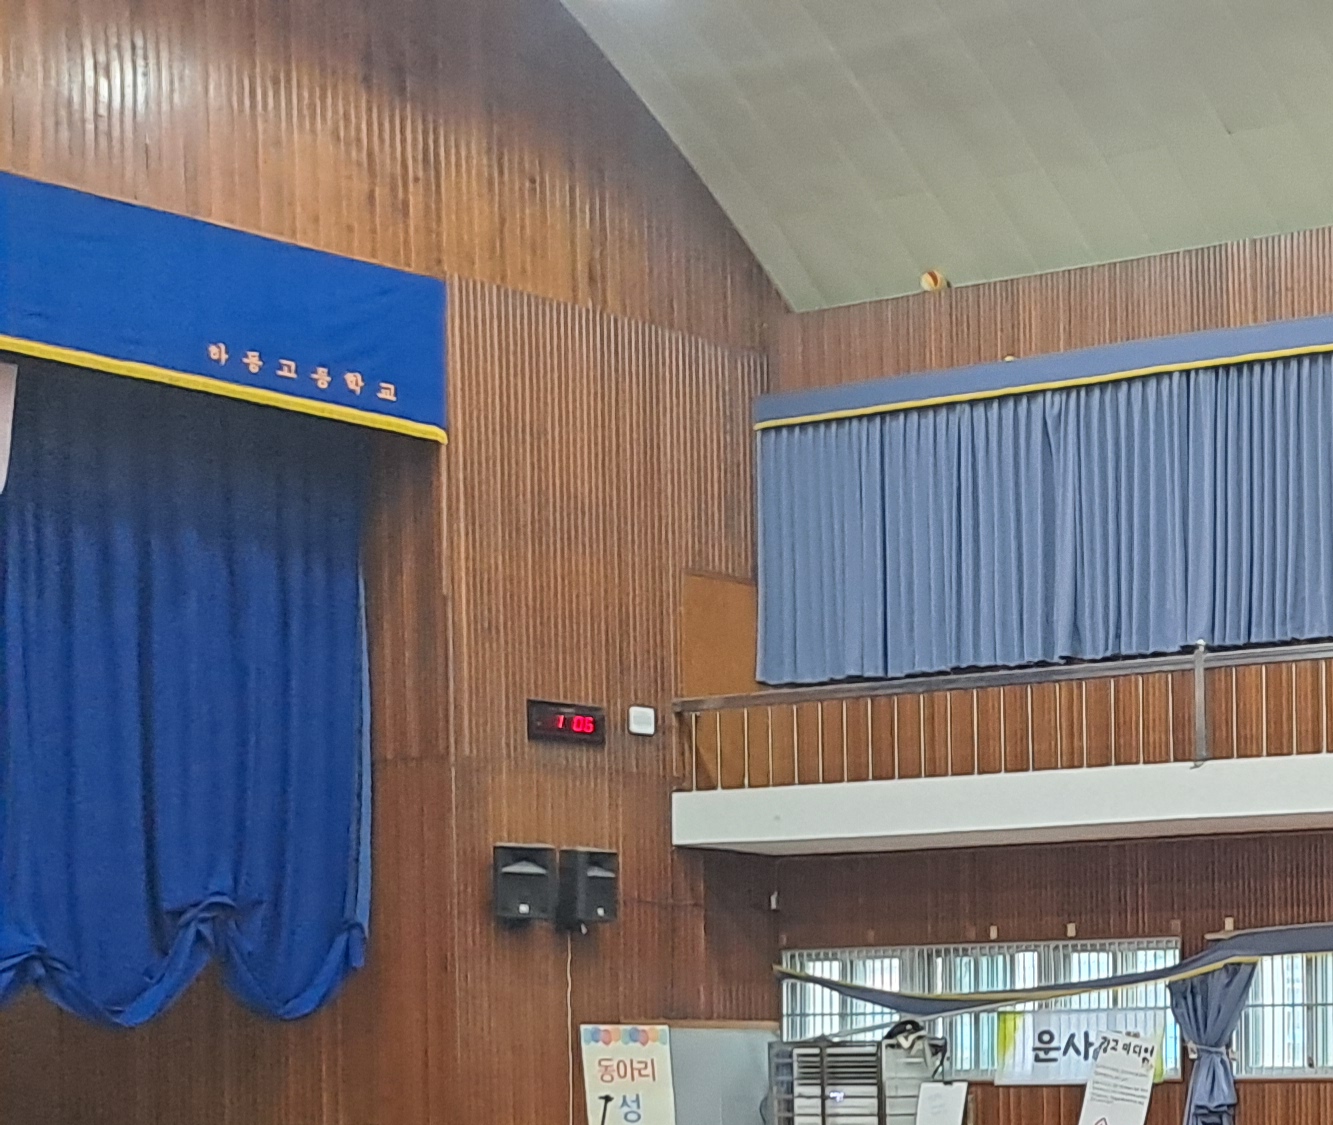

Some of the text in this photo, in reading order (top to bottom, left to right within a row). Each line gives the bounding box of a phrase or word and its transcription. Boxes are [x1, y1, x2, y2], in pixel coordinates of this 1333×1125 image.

[207, 342, 397, 402] 하동고등학교
[1032, 1030, 1100, 1063] 운사
[597, 1058, 657, 1084] 동아리
